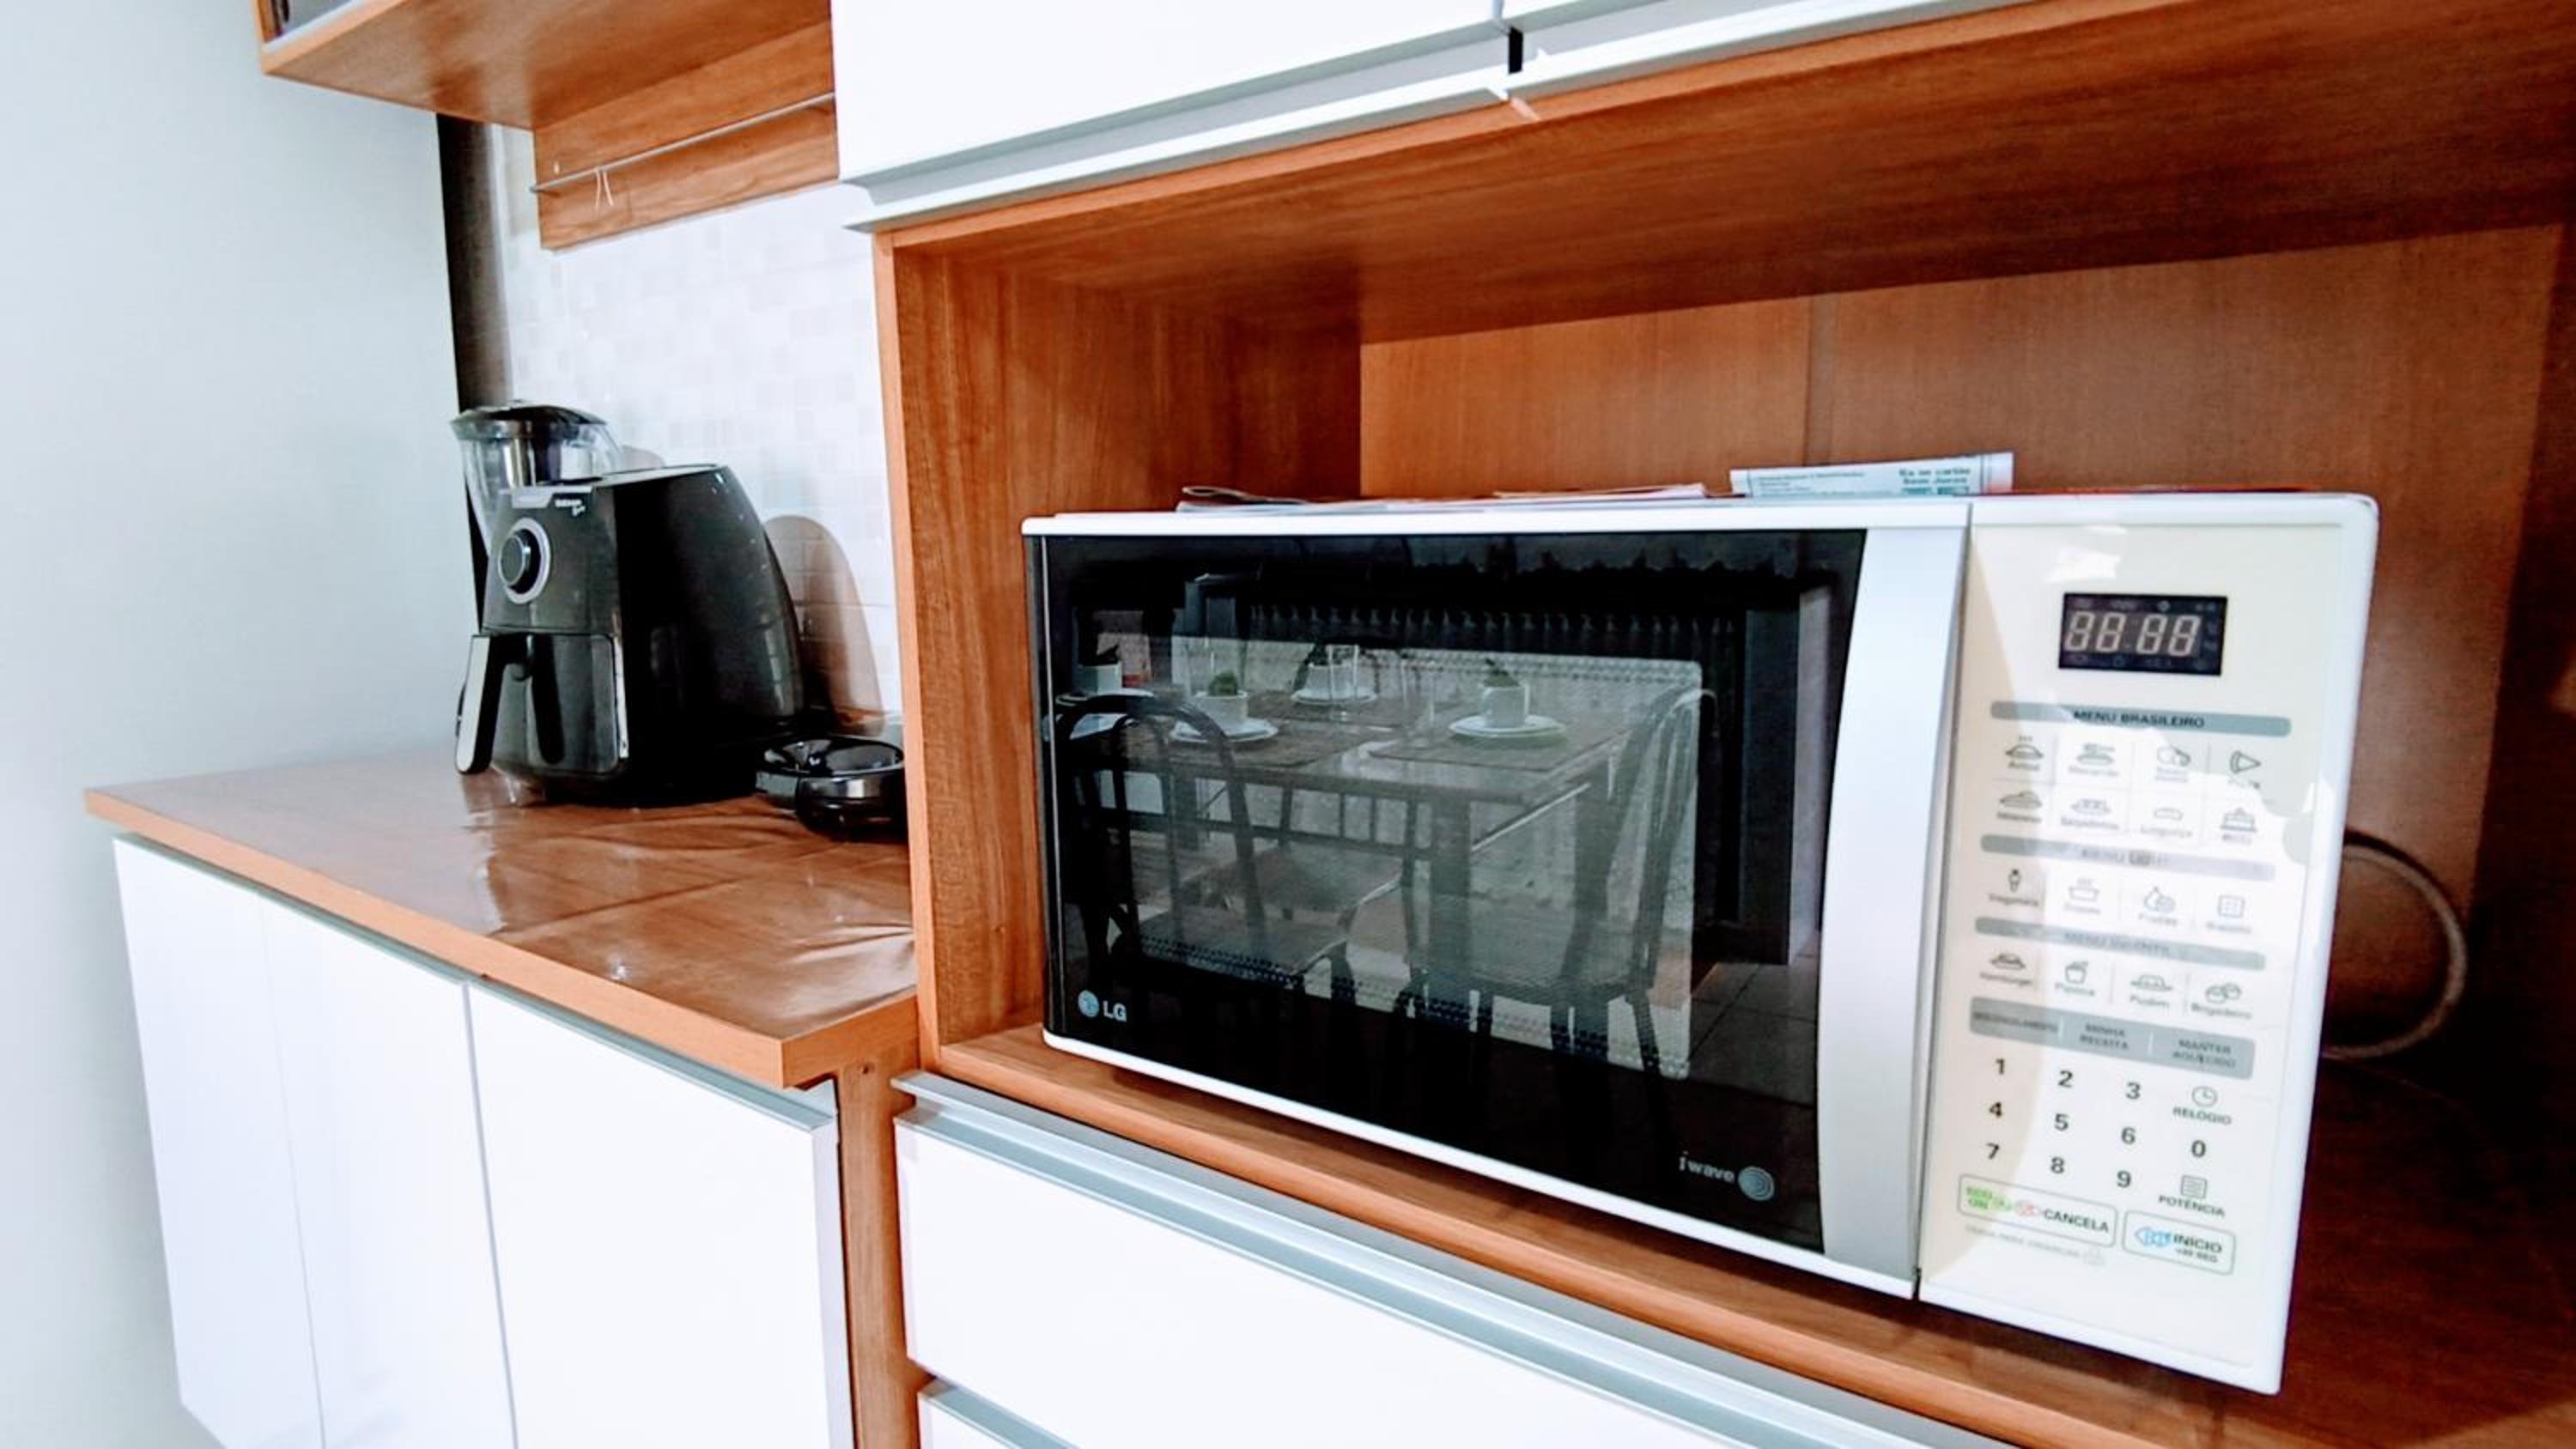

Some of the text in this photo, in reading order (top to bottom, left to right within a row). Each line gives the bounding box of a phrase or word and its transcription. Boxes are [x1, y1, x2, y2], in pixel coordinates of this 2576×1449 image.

[2073, 710, 2206, 728] MENU BRASILEIRO
[1102, 999, 1127, 1022] LG
[1996, 1058, 2006, 1075] 1
[2057, 1070, 2075, 1088] 2
[2126, 1082, 2142, 1100] 3
[1989, 1101, 2003, 1118] 4
[2054, 1113, 2069, 1131] 5
[2121, 1126, 2136, 1145] 6
[1986, 1143, 2000, 1160] 7
[2191, 1140, 2207, 1158] 0
[2050, 1156, 2066, 1174] 8
[2117, 1170, 2132, 1188] 9
[2043, 1208, 2109, 1233] CANCELA
